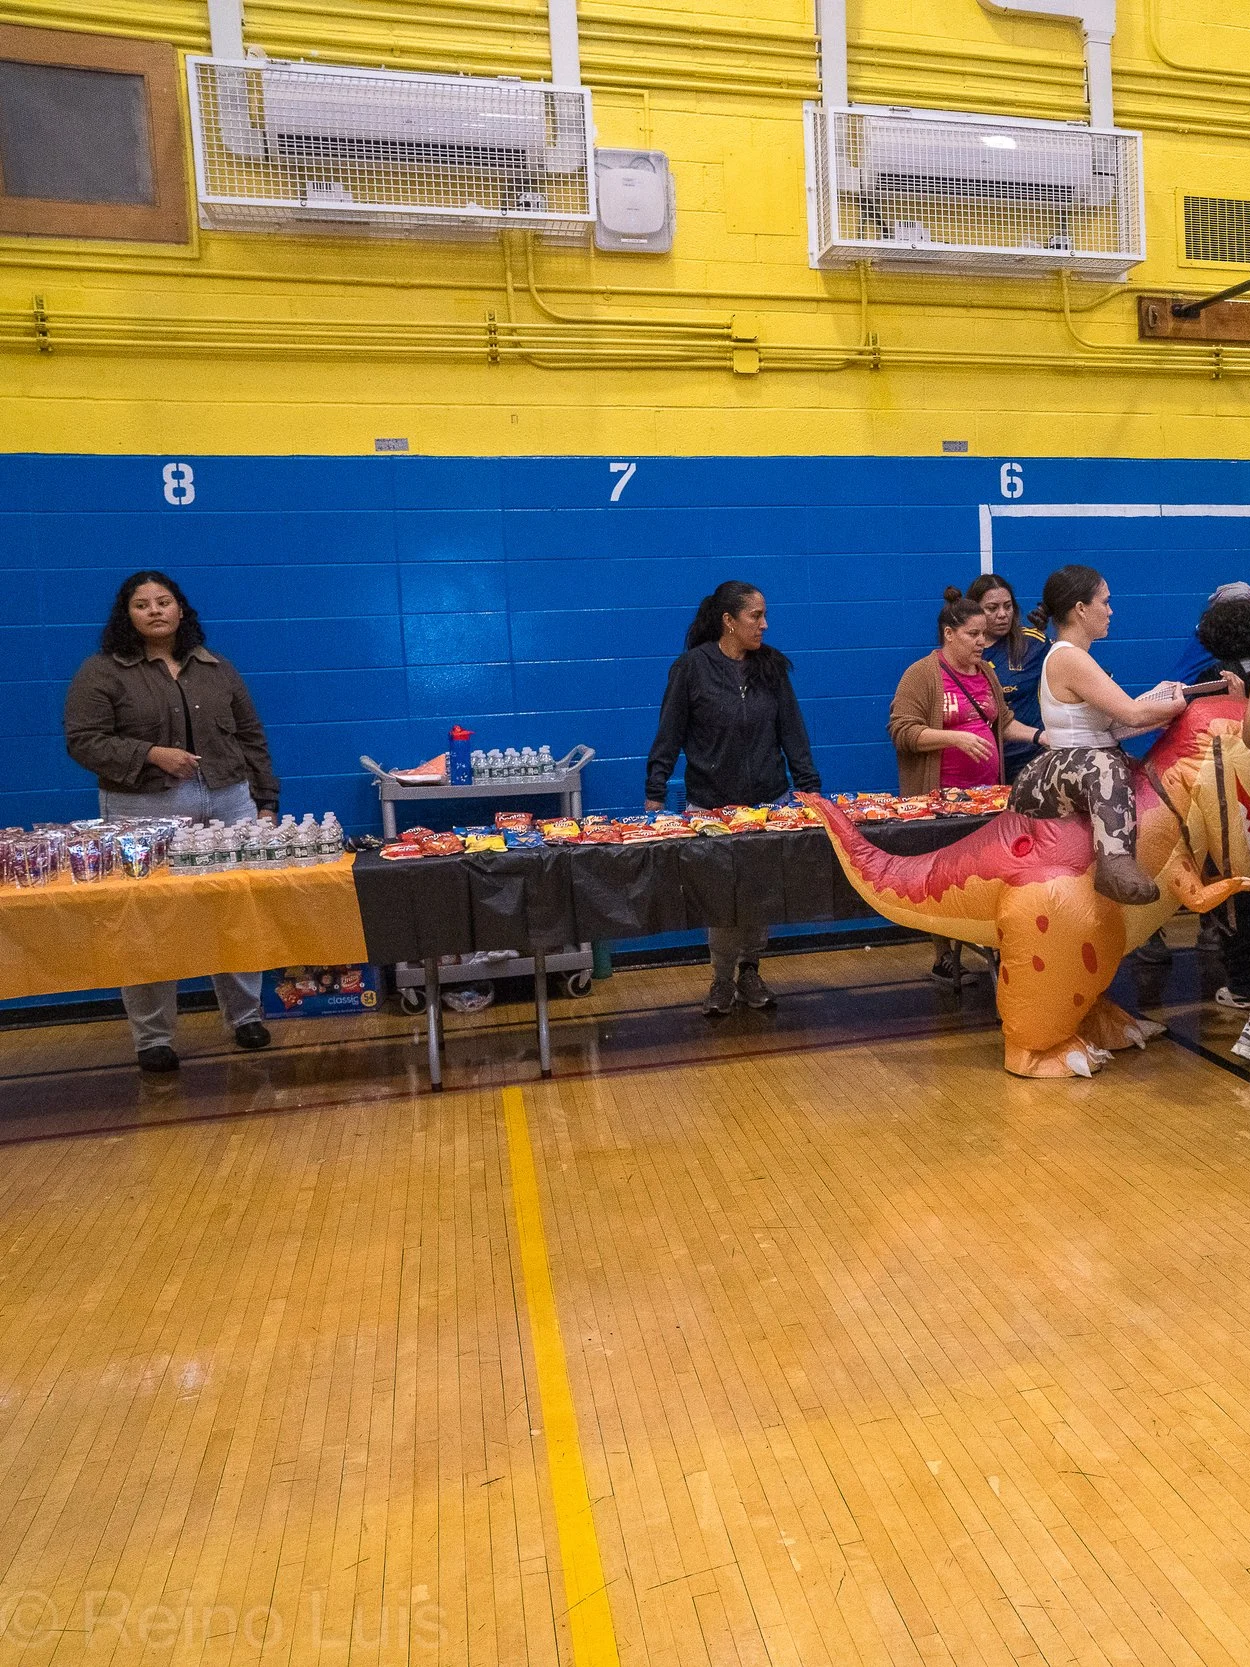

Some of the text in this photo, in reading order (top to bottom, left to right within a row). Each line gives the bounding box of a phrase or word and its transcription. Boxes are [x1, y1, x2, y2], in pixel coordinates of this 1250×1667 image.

[163, 463, 195, 505] 8
[610, 463, 637, 502] 7
[1000, 462, 1024, 498] 6
[327, 995, 359, 1005] classic
